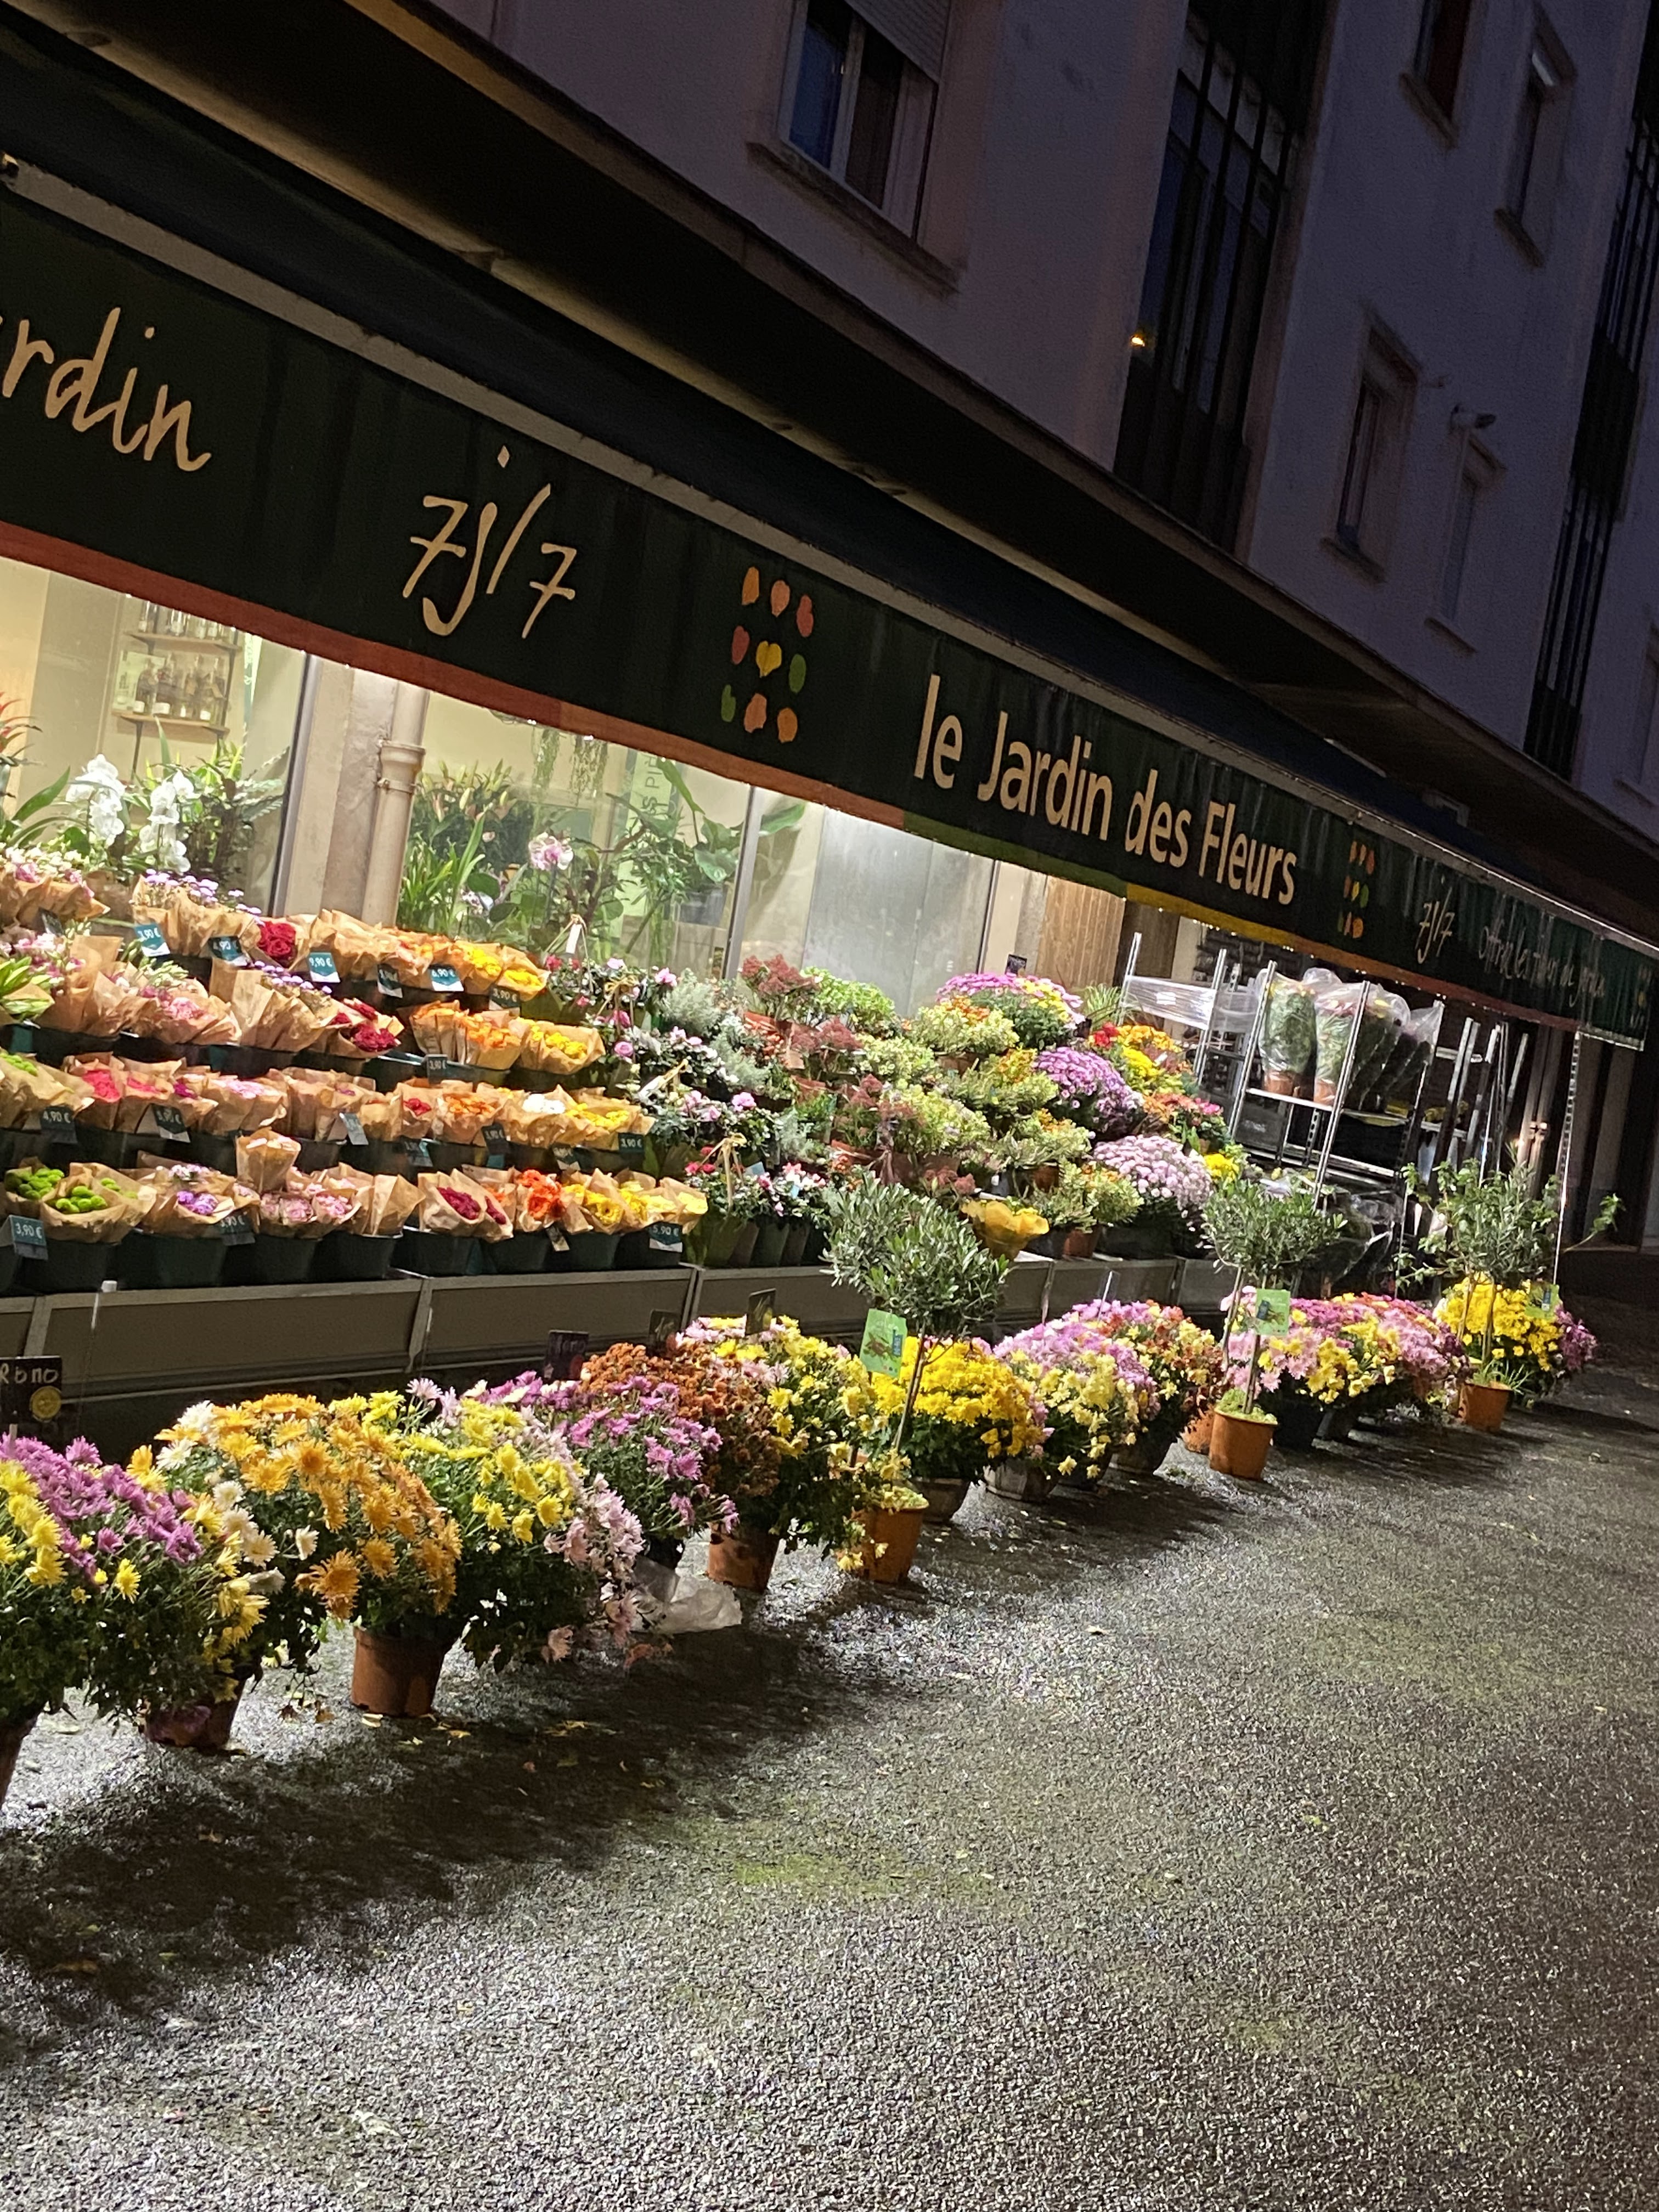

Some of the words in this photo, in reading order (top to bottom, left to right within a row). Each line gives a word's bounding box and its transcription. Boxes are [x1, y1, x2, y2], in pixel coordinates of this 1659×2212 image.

[0, 307, 212, 471] rdin
[402, 444, 577, 639] 7j/7
[913, 674, 963, 789] le
[977, 710, 1113, 842] Jardin
[1124, 769, 1191, 868] des
[1198, 800, 1297, 905] Fleurs
[1414, 873, 1455, 965] 7j/7
[15, 1222, 35, 1237] 3,90
[36, 1226, 43, 1239] €
